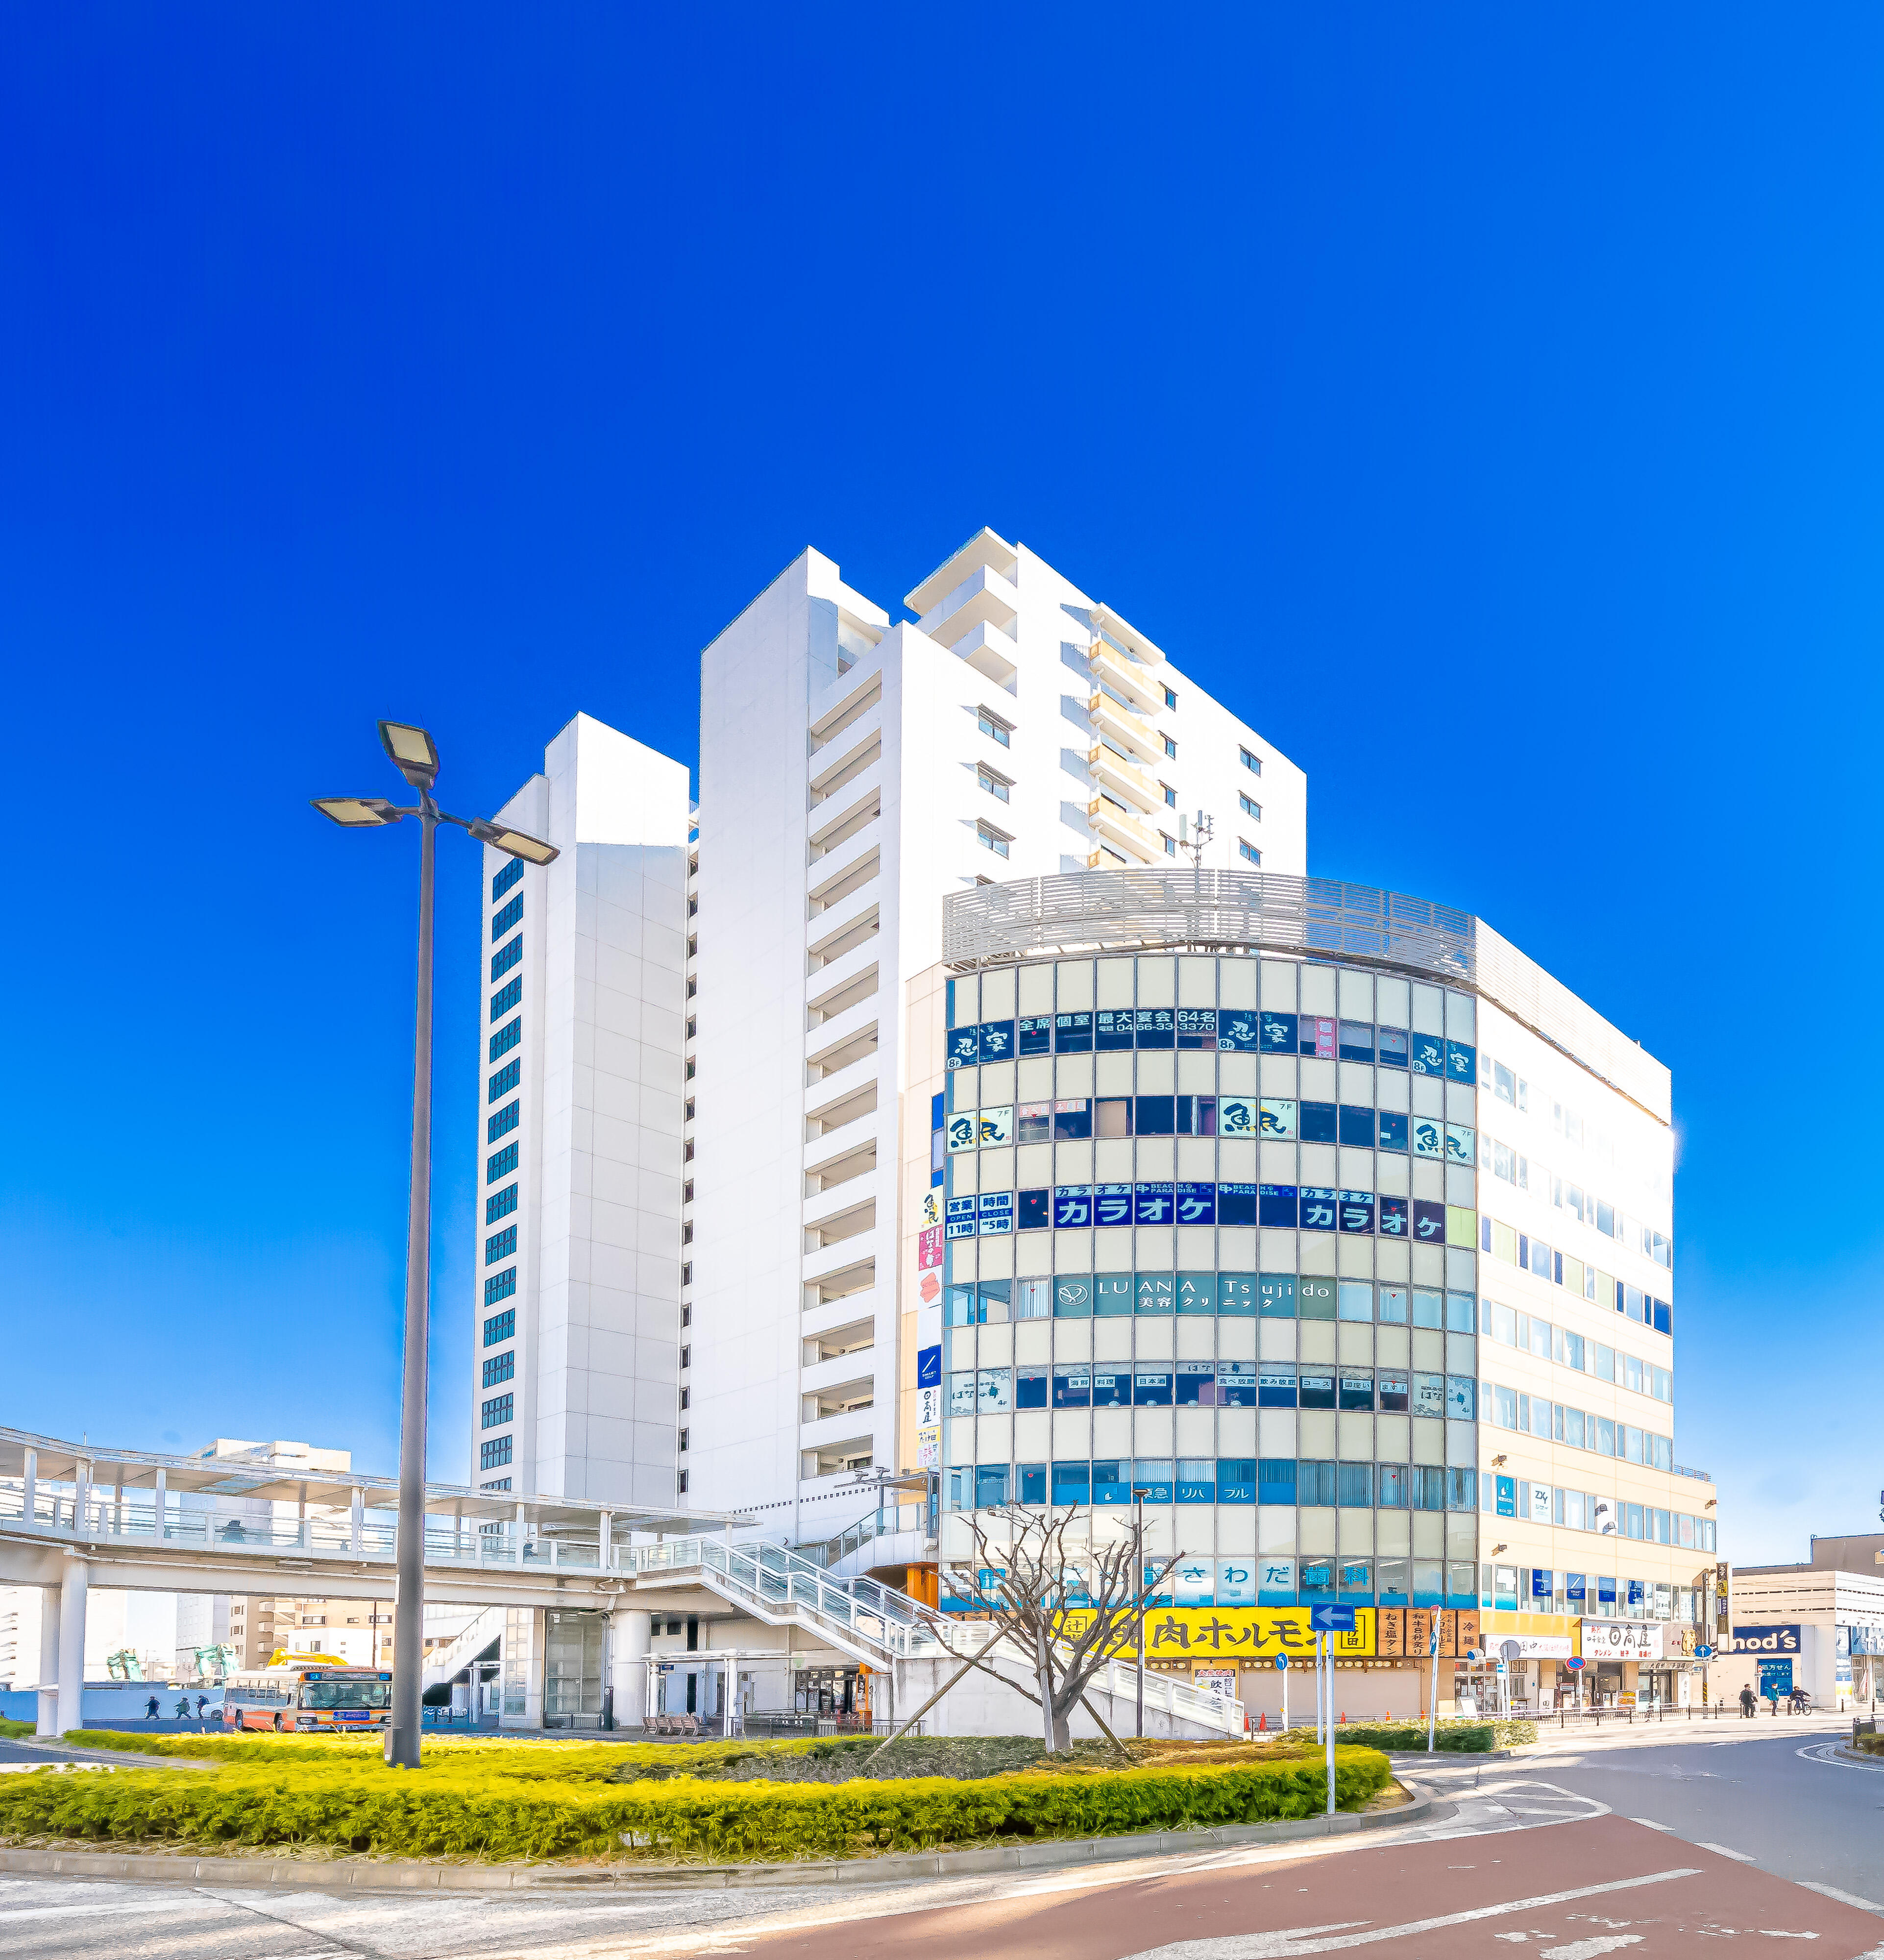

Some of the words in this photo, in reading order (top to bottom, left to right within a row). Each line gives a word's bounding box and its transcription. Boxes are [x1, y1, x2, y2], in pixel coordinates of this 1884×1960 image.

[1020, 1015, 1090, 1031] 全席個室
[1098, 1011, 1216, 1024] 最大宴会64名
[1116, 1023, 1214, 1031] 0466-33-3370
[1220, 1040, 1233, 1048] 8F
[949, 1058, 959, 1067] 8F
[1414, 1062, 1424, 1072] 8F
[1059, 1185, 1128, 1196] カラオケ
[1304, 1188, 1369, 1202] カラオケ
[949, 1196, 1009, 1212] 営業時間
[1058, 1198, 1211, 1224] カラオケ
[1307, 1205, 1441, 1236] カラオケ
[949, 1223, 973, 1234] 11時
[1099, 1280, 1197, 1294] LUANA
[1224, 1280, 1330, 1299] Tsujido
[1138, 1297, 1273, 1308] 美容クリニック
[1384, 1612, 1398, 1655] ねぎ塩タン
